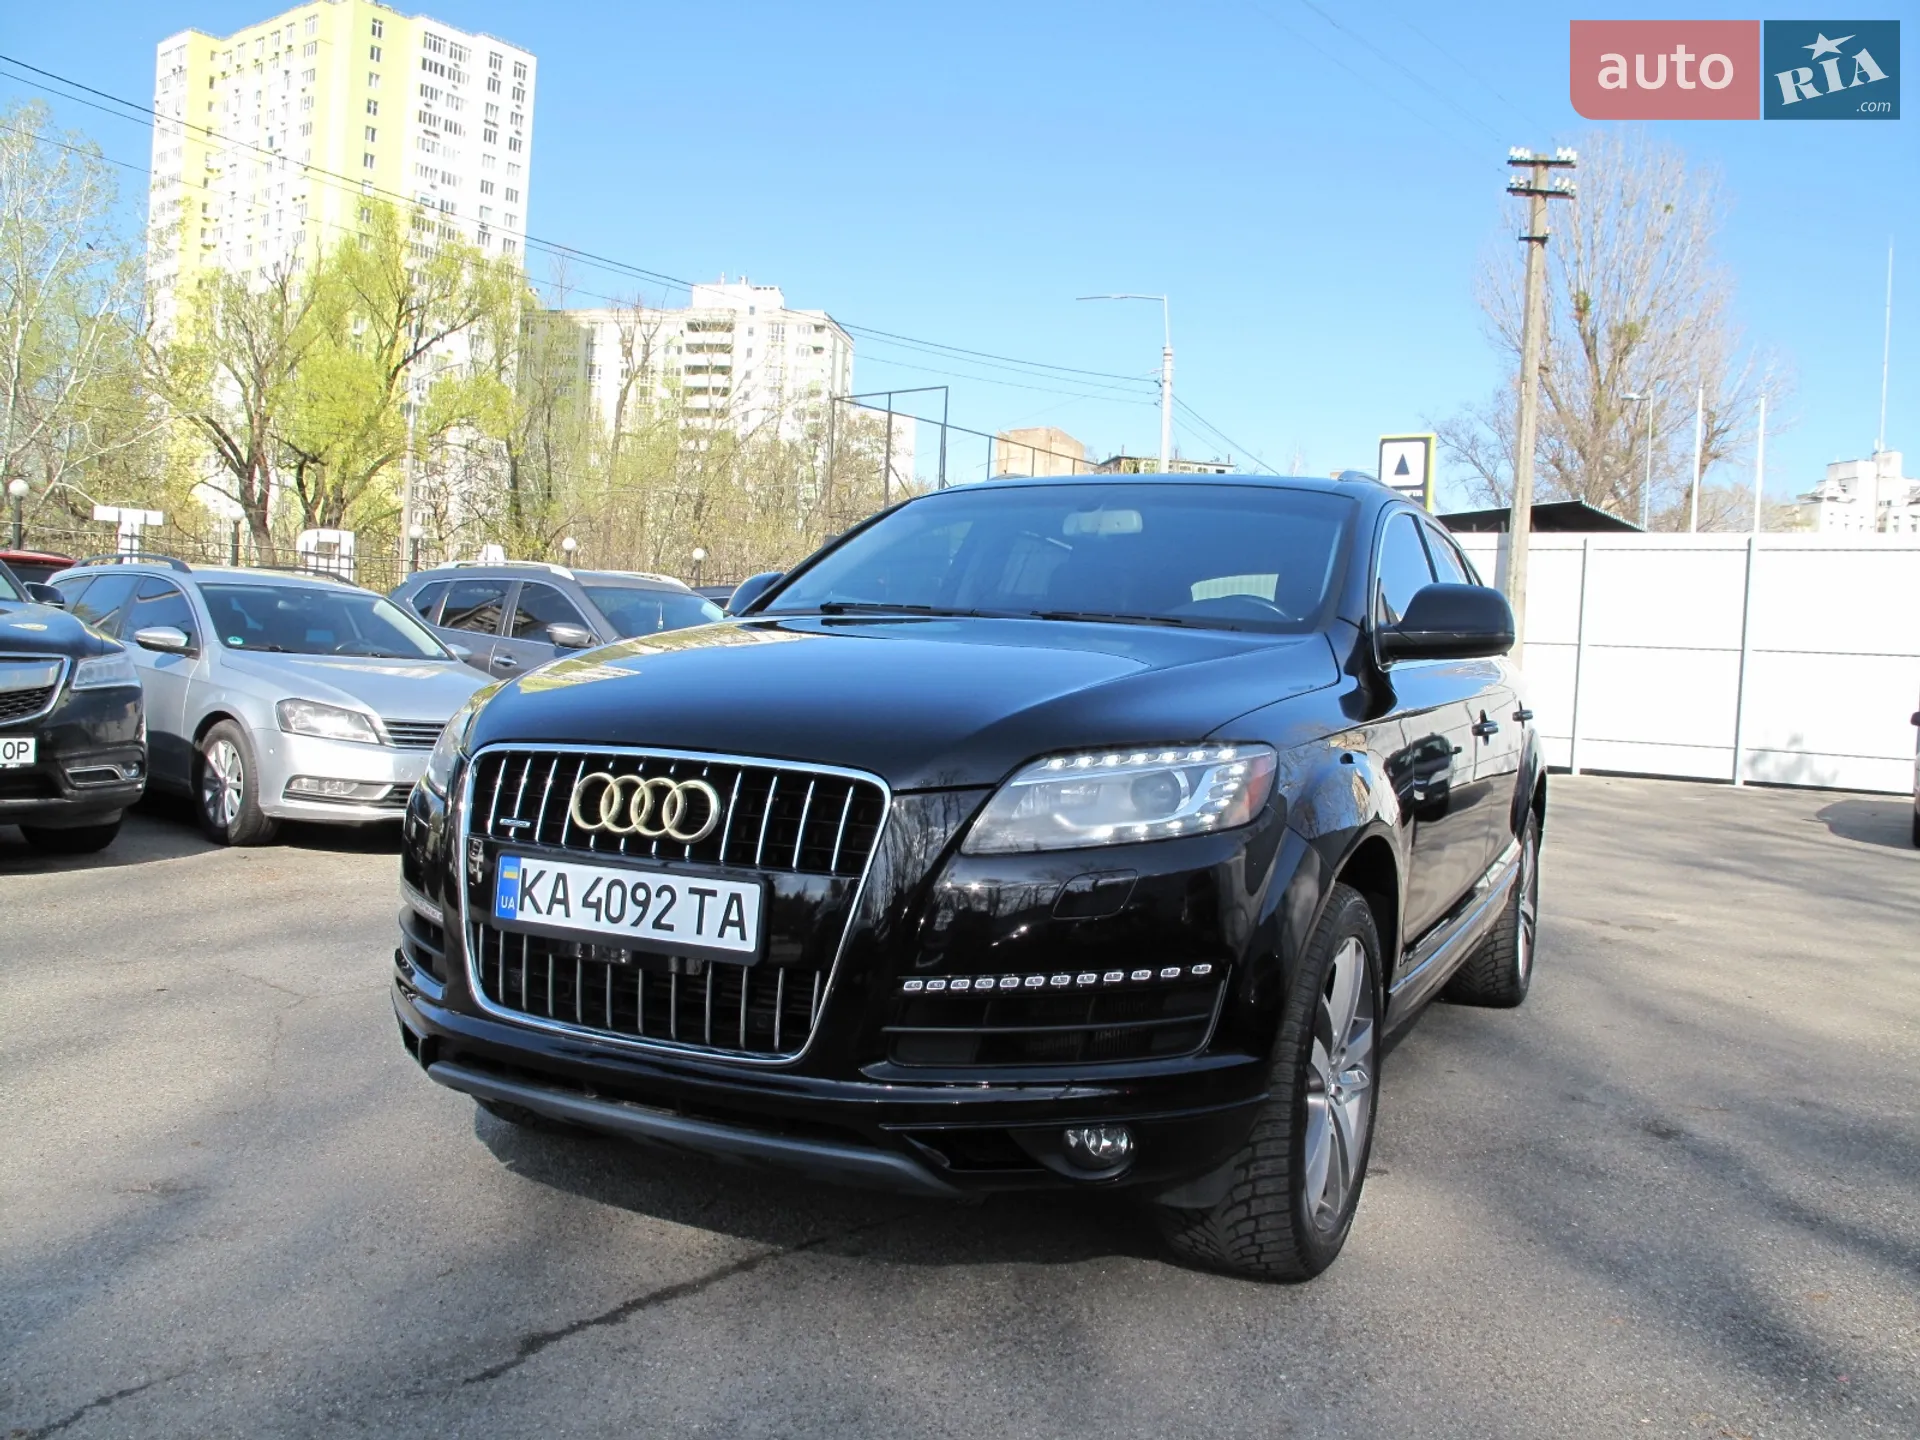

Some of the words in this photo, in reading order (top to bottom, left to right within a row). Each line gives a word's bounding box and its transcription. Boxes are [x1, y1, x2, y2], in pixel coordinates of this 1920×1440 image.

[501, 895, 515, 910] UA
[518, 867, 571, 918] KA
[581, 876, 677, 932] 4092
[688, 887, 747, 941] TA
